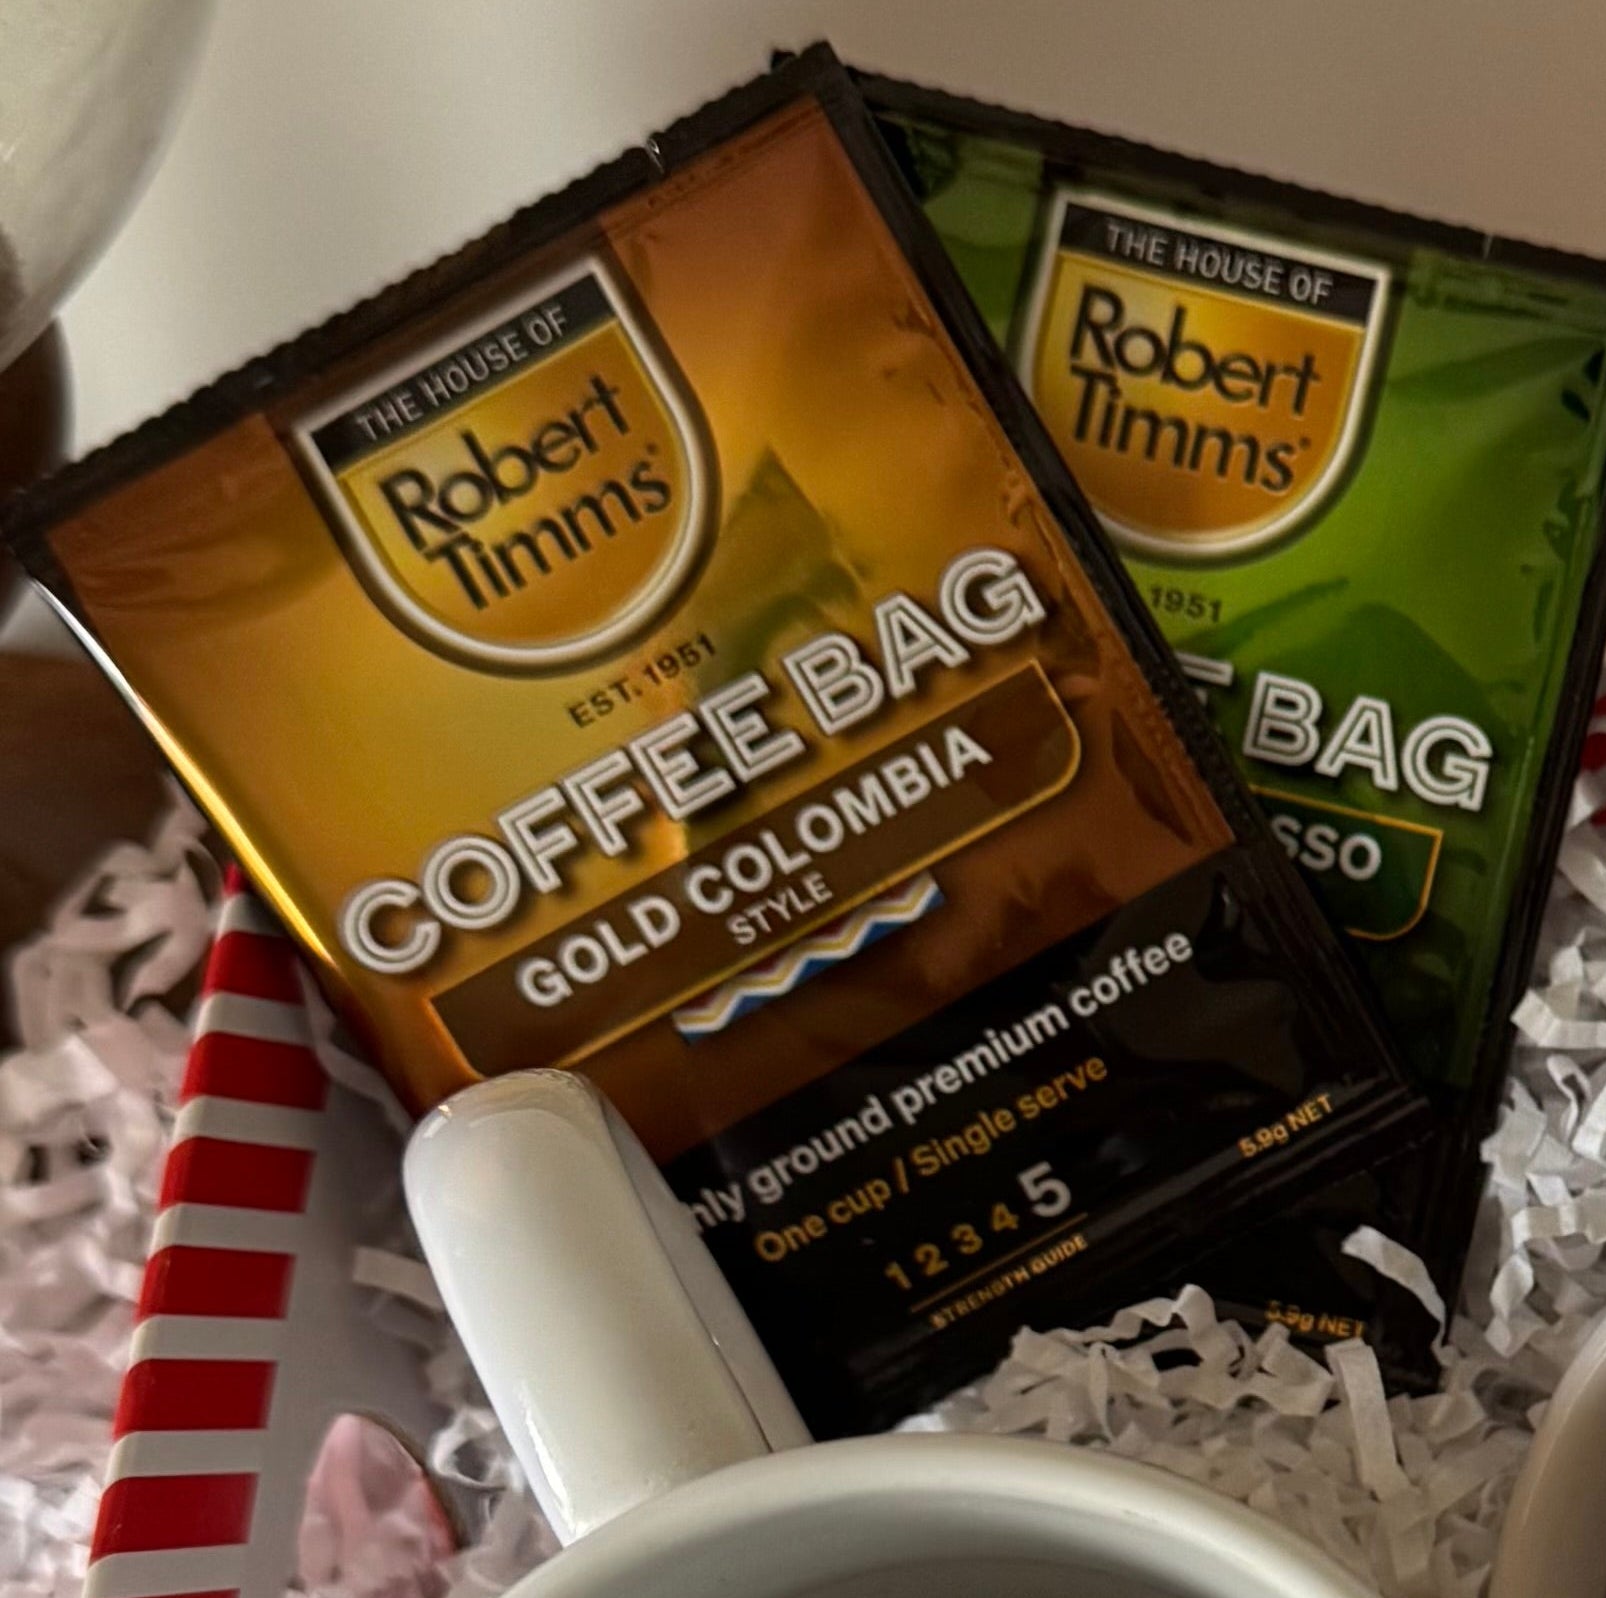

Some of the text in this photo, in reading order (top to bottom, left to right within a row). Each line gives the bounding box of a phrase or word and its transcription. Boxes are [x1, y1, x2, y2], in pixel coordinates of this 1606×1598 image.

[1107, 223, 1334, 306] THE HOUSE OF
[356, 306, 569, 441] THE HOUSE OF
[1069, 284, 1319, 415] Robert
[378, 373, 628, 552] Robert
[1070, 365, 1294, 493] Timms
[424, 460, 671, 610] Timms
[1149, 583, 1223, 623] 1951
[567, 632, 717, 729] EST. 1951
[1243, 671, 1493, 812] BAG
[339, 549, 1048, 974] COFFEE BAG
[516, 725, 994, 1007] GOLD COLOMBIA
[727, 872, 833, 947] STYLE
[1270, 813, 1382, 881] SSO
[747, 1095, 892, 1205] ground
[890, 1003, 1070, 1124] premium
[1068, 932, 1194, 1018] coffee
[1238, 1092, 1334, 1159] 5.9g NET
[754, 1210, 827, 1263] One
[828, 1174, 891, 1225] cup
[910, 1105, 1017, 1178] Single
[1015, 1055, 1108, 1121] serve
[884, 1161, 1072, 1290] 1 2 3 4 5
[929, 1233, 1088, 1330] STRENGTH GUIDE
